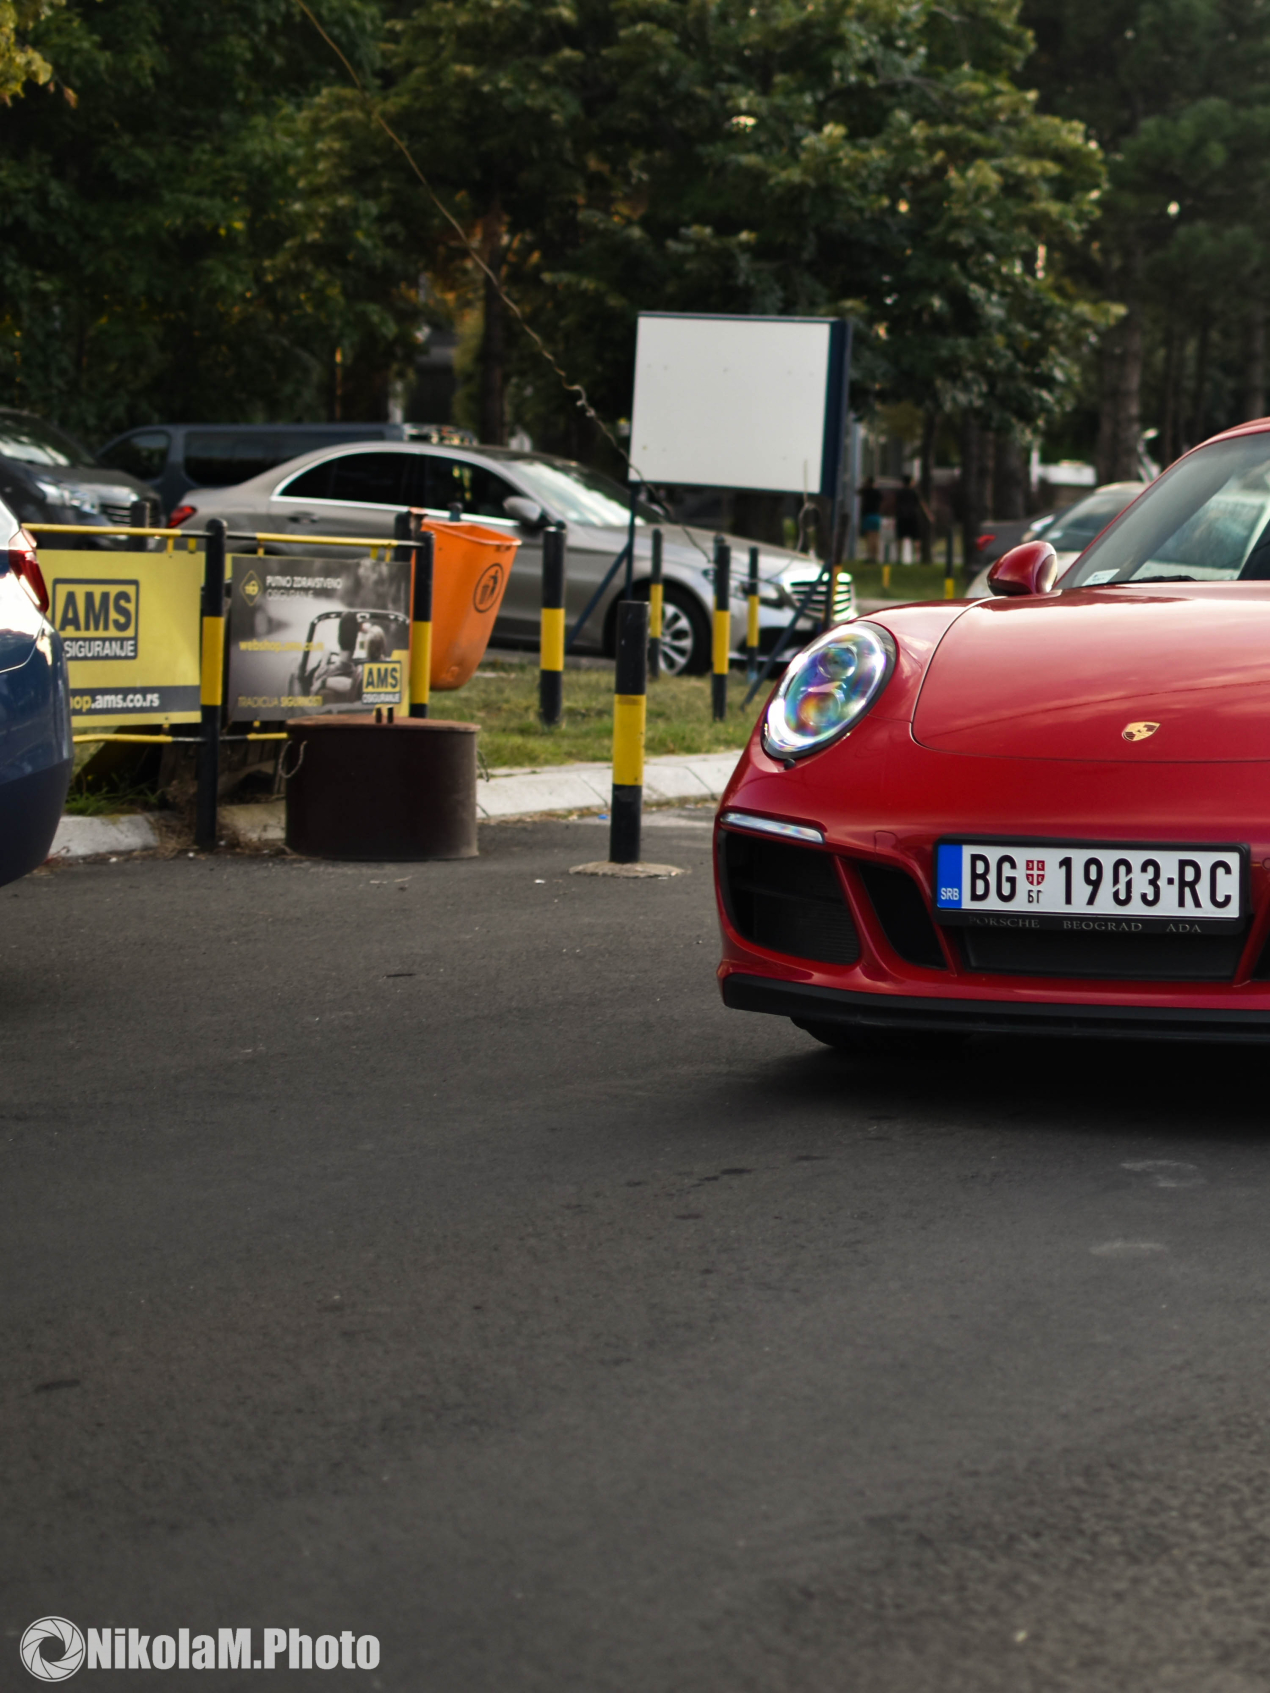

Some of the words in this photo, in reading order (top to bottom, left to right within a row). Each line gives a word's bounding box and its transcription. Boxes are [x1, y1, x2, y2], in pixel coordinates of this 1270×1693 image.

[59, 590, 132, 632] AMS
[64, 640, 135, 658] SIGURANJE
[365, 667, 399, 689] AMS
[70, 693, 160, 712] op.ams.co.rs
[969, 853, 1017, 903] BG
[940, 887, 960, 901] SRB
[968, 915, 1040, 928] PORSCHE
[1063, 920, 1142, 932] BEOGRAD
[1166, 923, 1202, 933] ADA
